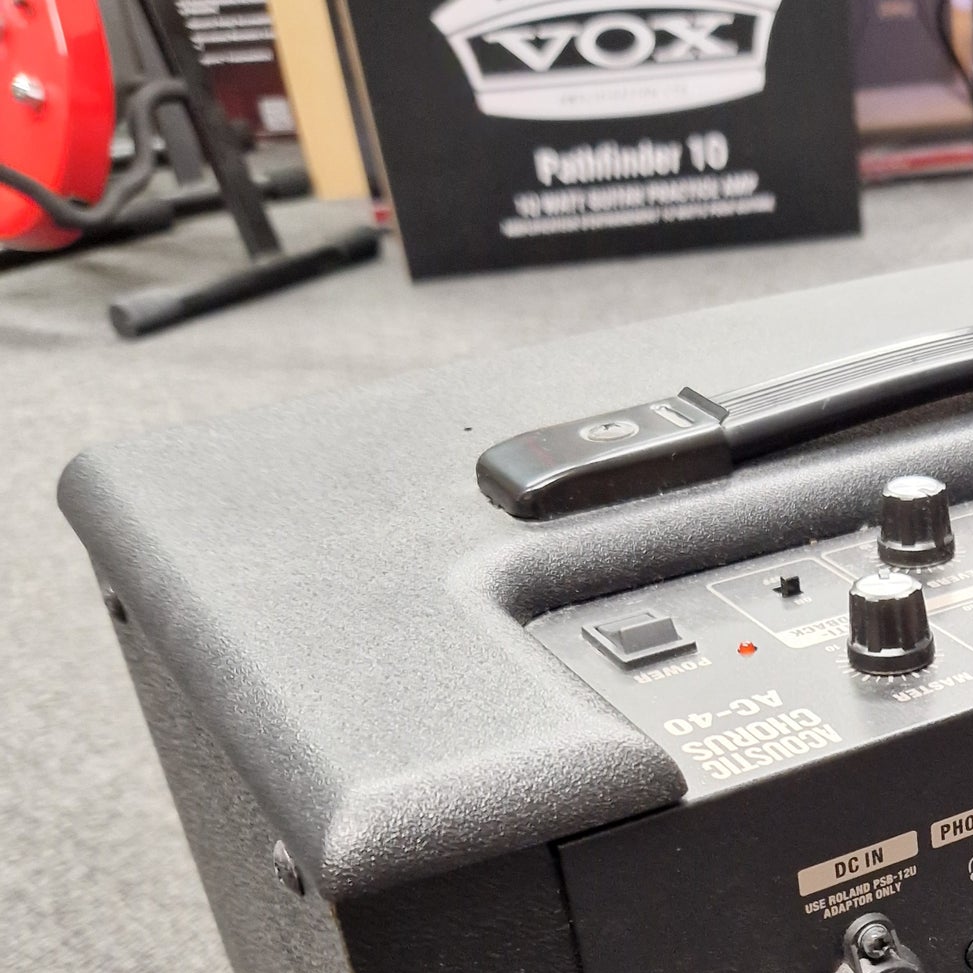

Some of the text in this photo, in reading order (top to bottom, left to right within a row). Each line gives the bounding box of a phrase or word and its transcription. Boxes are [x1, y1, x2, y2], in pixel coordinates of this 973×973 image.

[482, 12, 739, 72] VOX
[533, 130, 730, 186] Pathfinder 10
[633, 656, 713, 684] POWER
[892, 671, 973, 703] MASTER
[663, 688, 783, 737] AC-40
[680, 707, 823, 761] CHORUS
[701, 723, 844, 780] ACOUSTIC
[834, 846, 884, 879] DC IN
[804, 865, 918, 915] USE ROLAND PSB-12U
[823, 880, 903, 919] ADAPTOR ONLY
